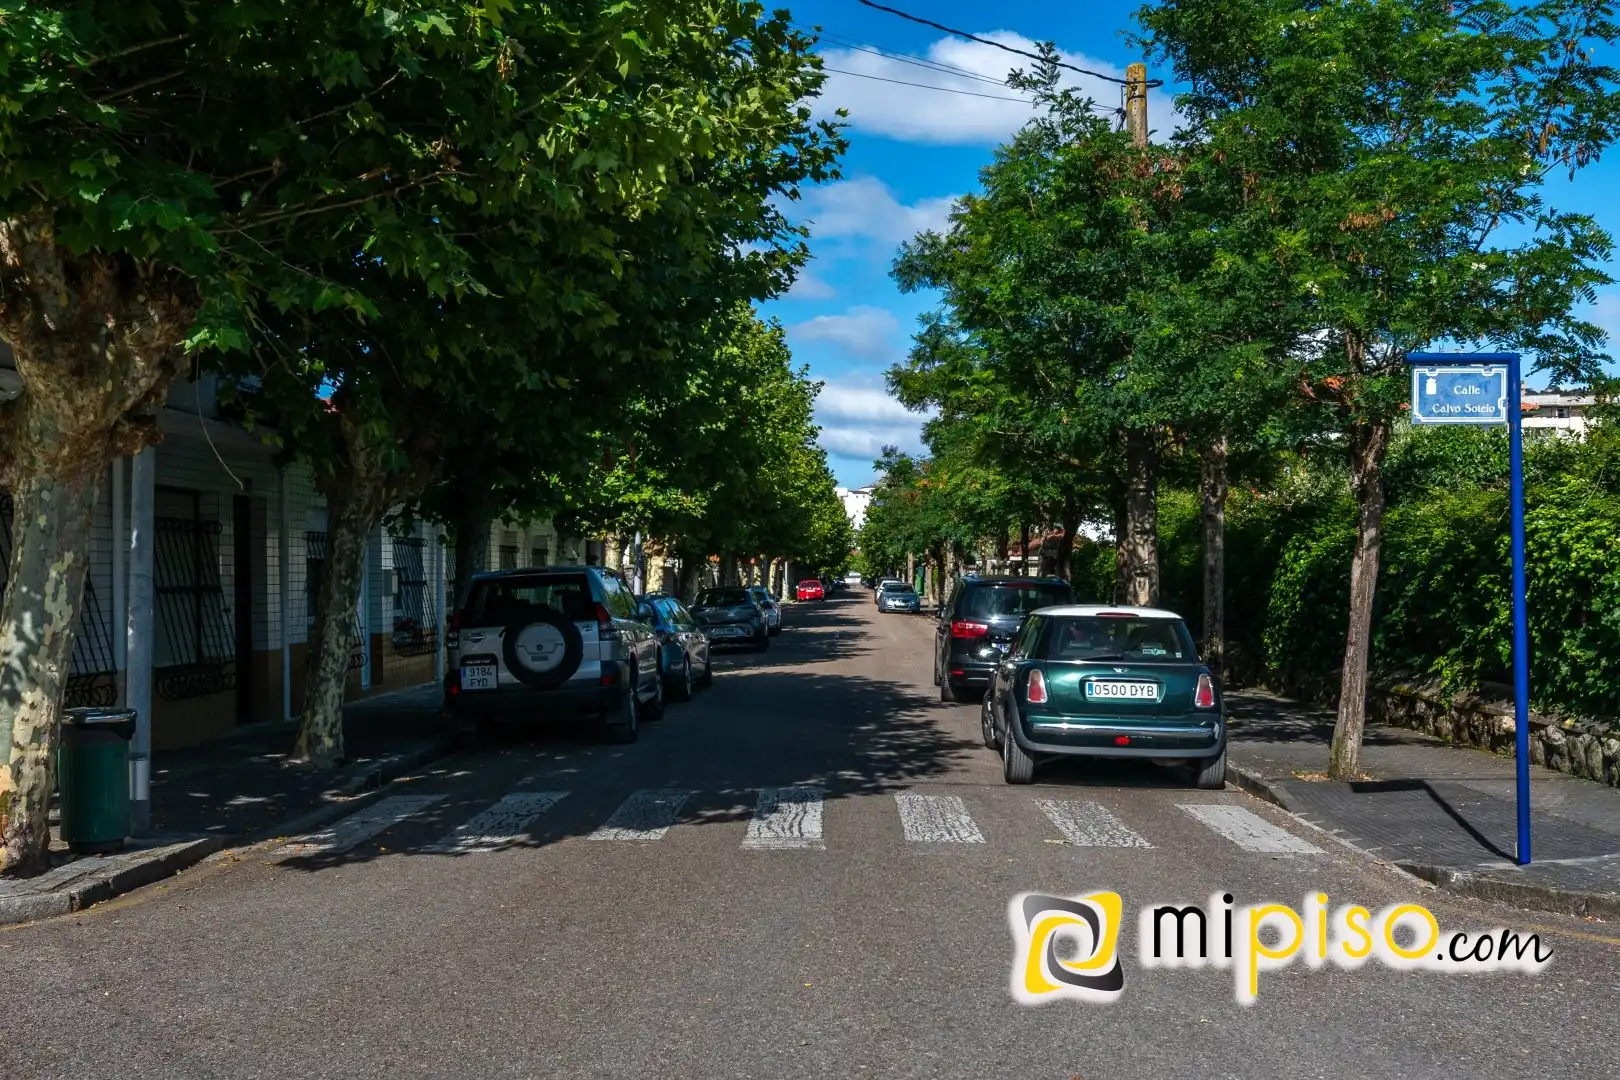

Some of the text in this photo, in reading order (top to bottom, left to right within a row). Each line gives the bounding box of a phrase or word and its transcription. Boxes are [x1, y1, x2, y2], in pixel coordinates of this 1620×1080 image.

[1453, 384, 1481, 395] Calle
[1432, 403, 1496, 413] Calvo Sotelo
[469, 667, 492, 677] 9184
[1094, 684, 1154, 697] 0500 DYB
